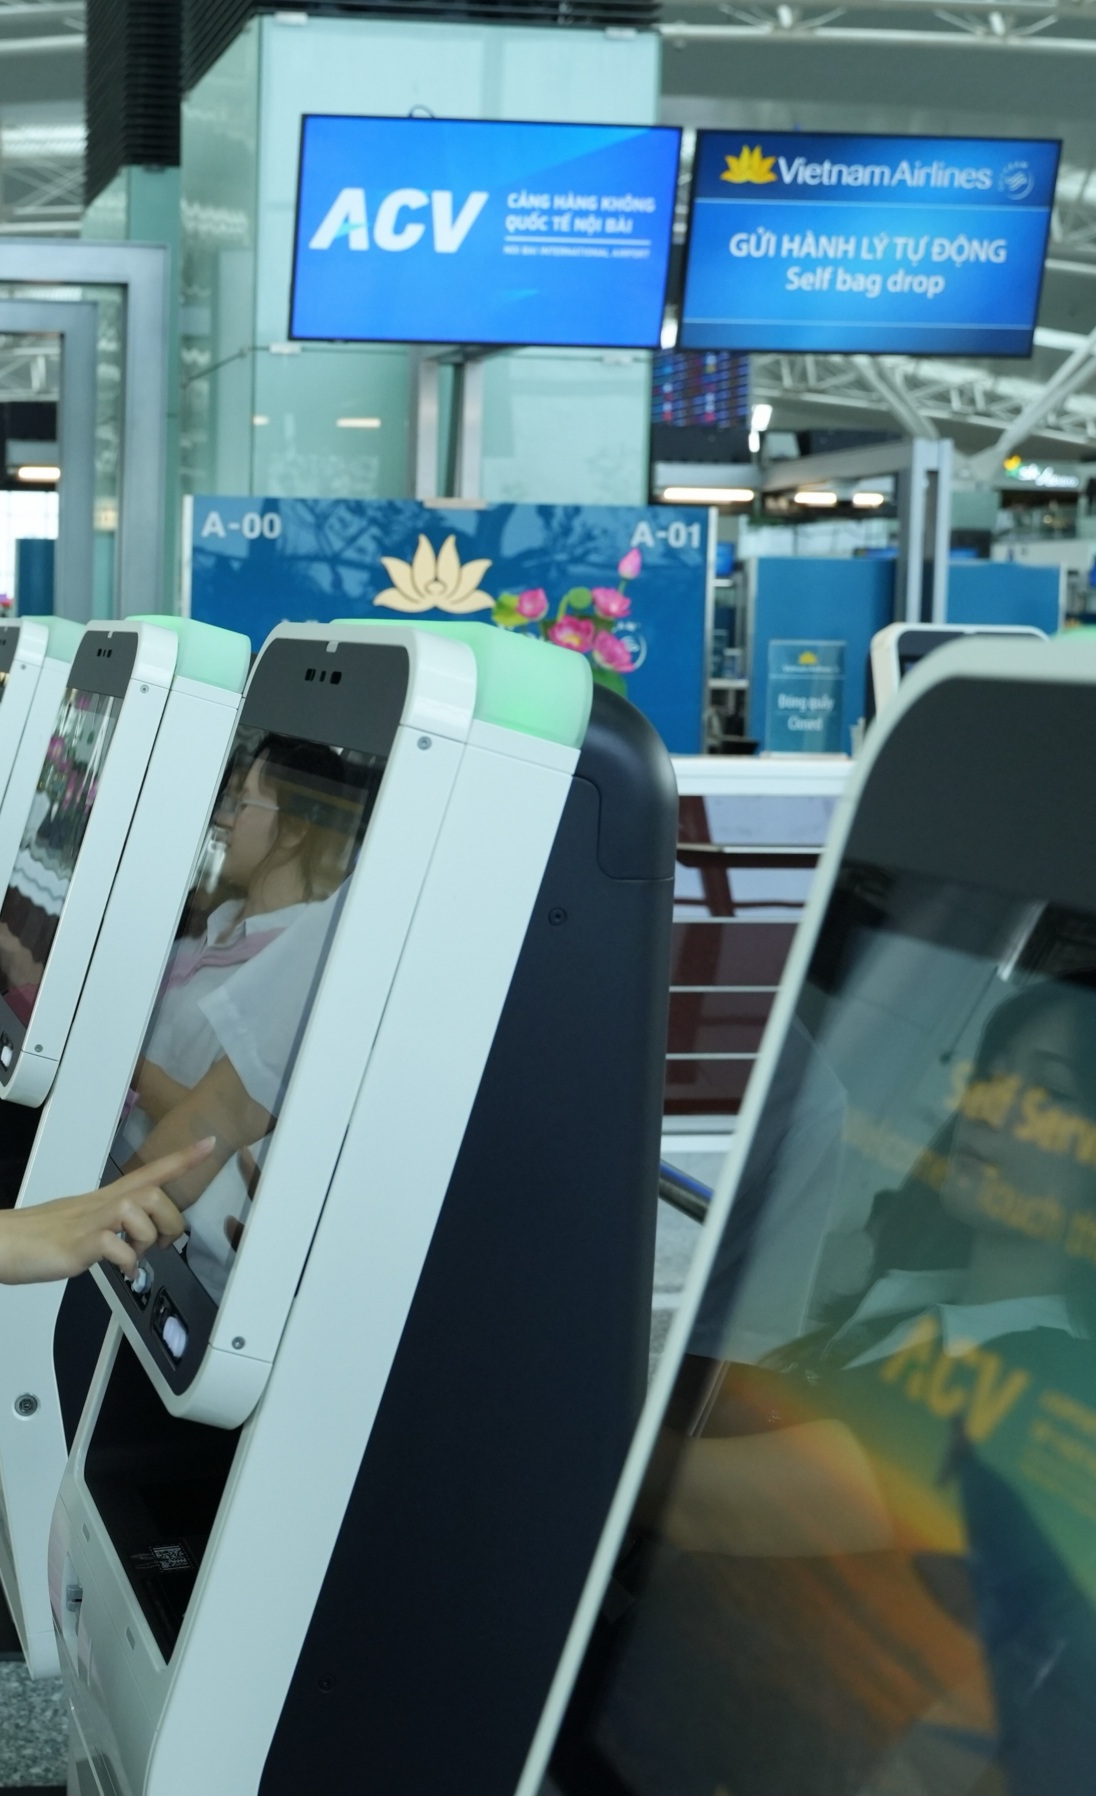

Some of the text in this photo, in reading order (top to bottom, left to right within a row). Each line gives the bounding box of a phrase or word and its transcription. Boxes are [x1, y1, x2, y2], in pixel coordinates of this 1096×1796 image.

[308, 187, 489, 254] ACV
[729, 227, 1008, 268] GỬI HÀNH LÝ TỰ ĐỘNG
[785, 266, 946, 299] Self bag drop
[201, 511, 282, 539] A-00
[630, 521, 701, 549] A-01
[881, 1315, 1030, 1442] ACV
